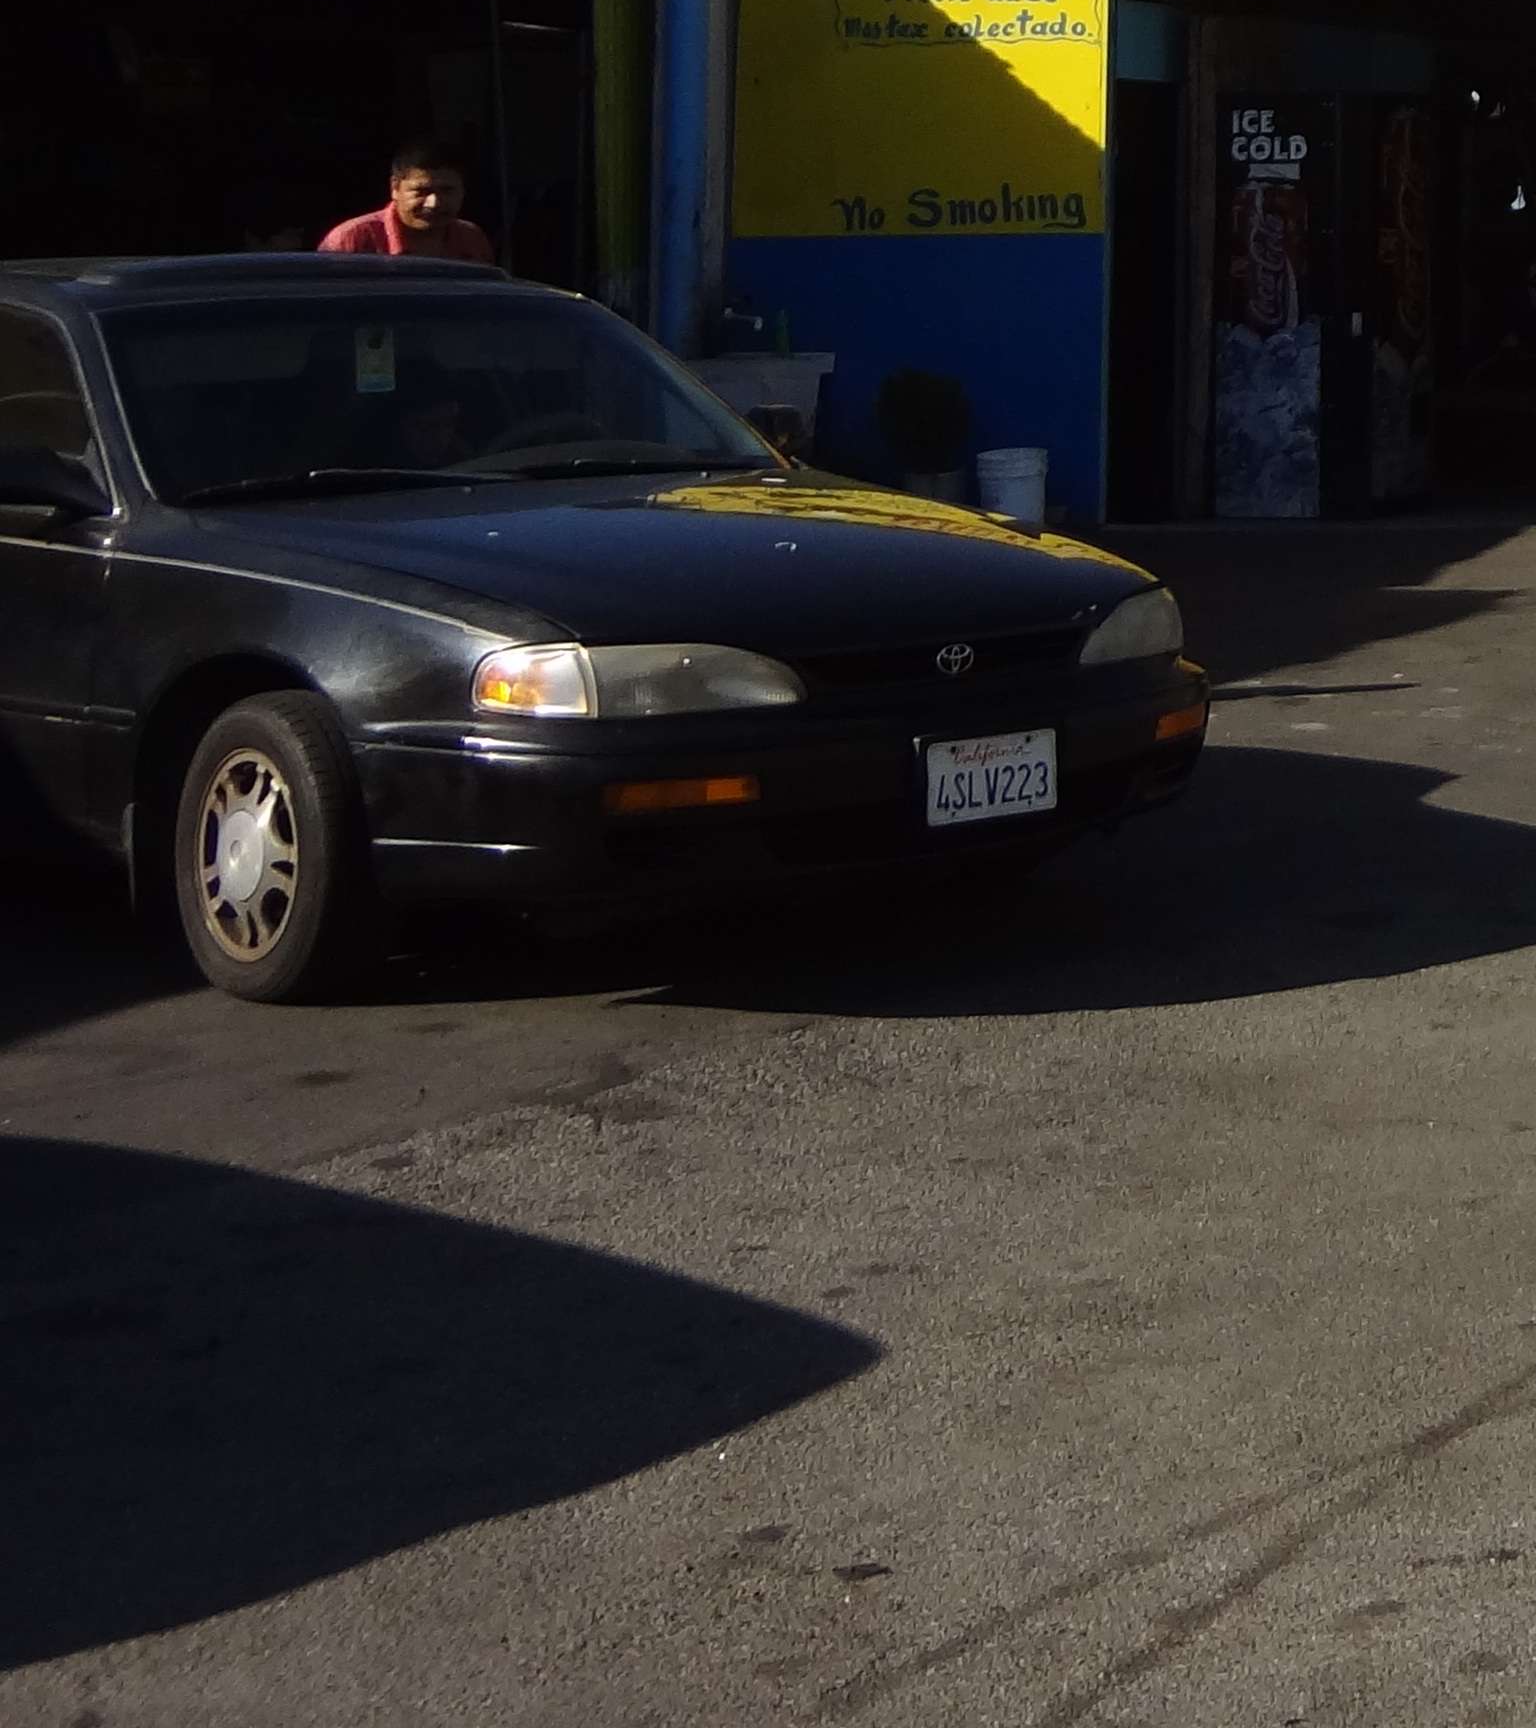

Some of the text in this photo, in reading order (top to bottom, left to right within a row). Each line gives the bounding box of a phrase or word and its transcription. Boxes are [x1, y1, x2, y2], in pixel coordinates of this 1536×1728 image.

[1232, 110, 1275, 134] ICE
[1231, 135, 1308, 161] COLD
[832, 181, 1087, 233] No Smoking
[937, 760, 1049, 811] 4SLV223
